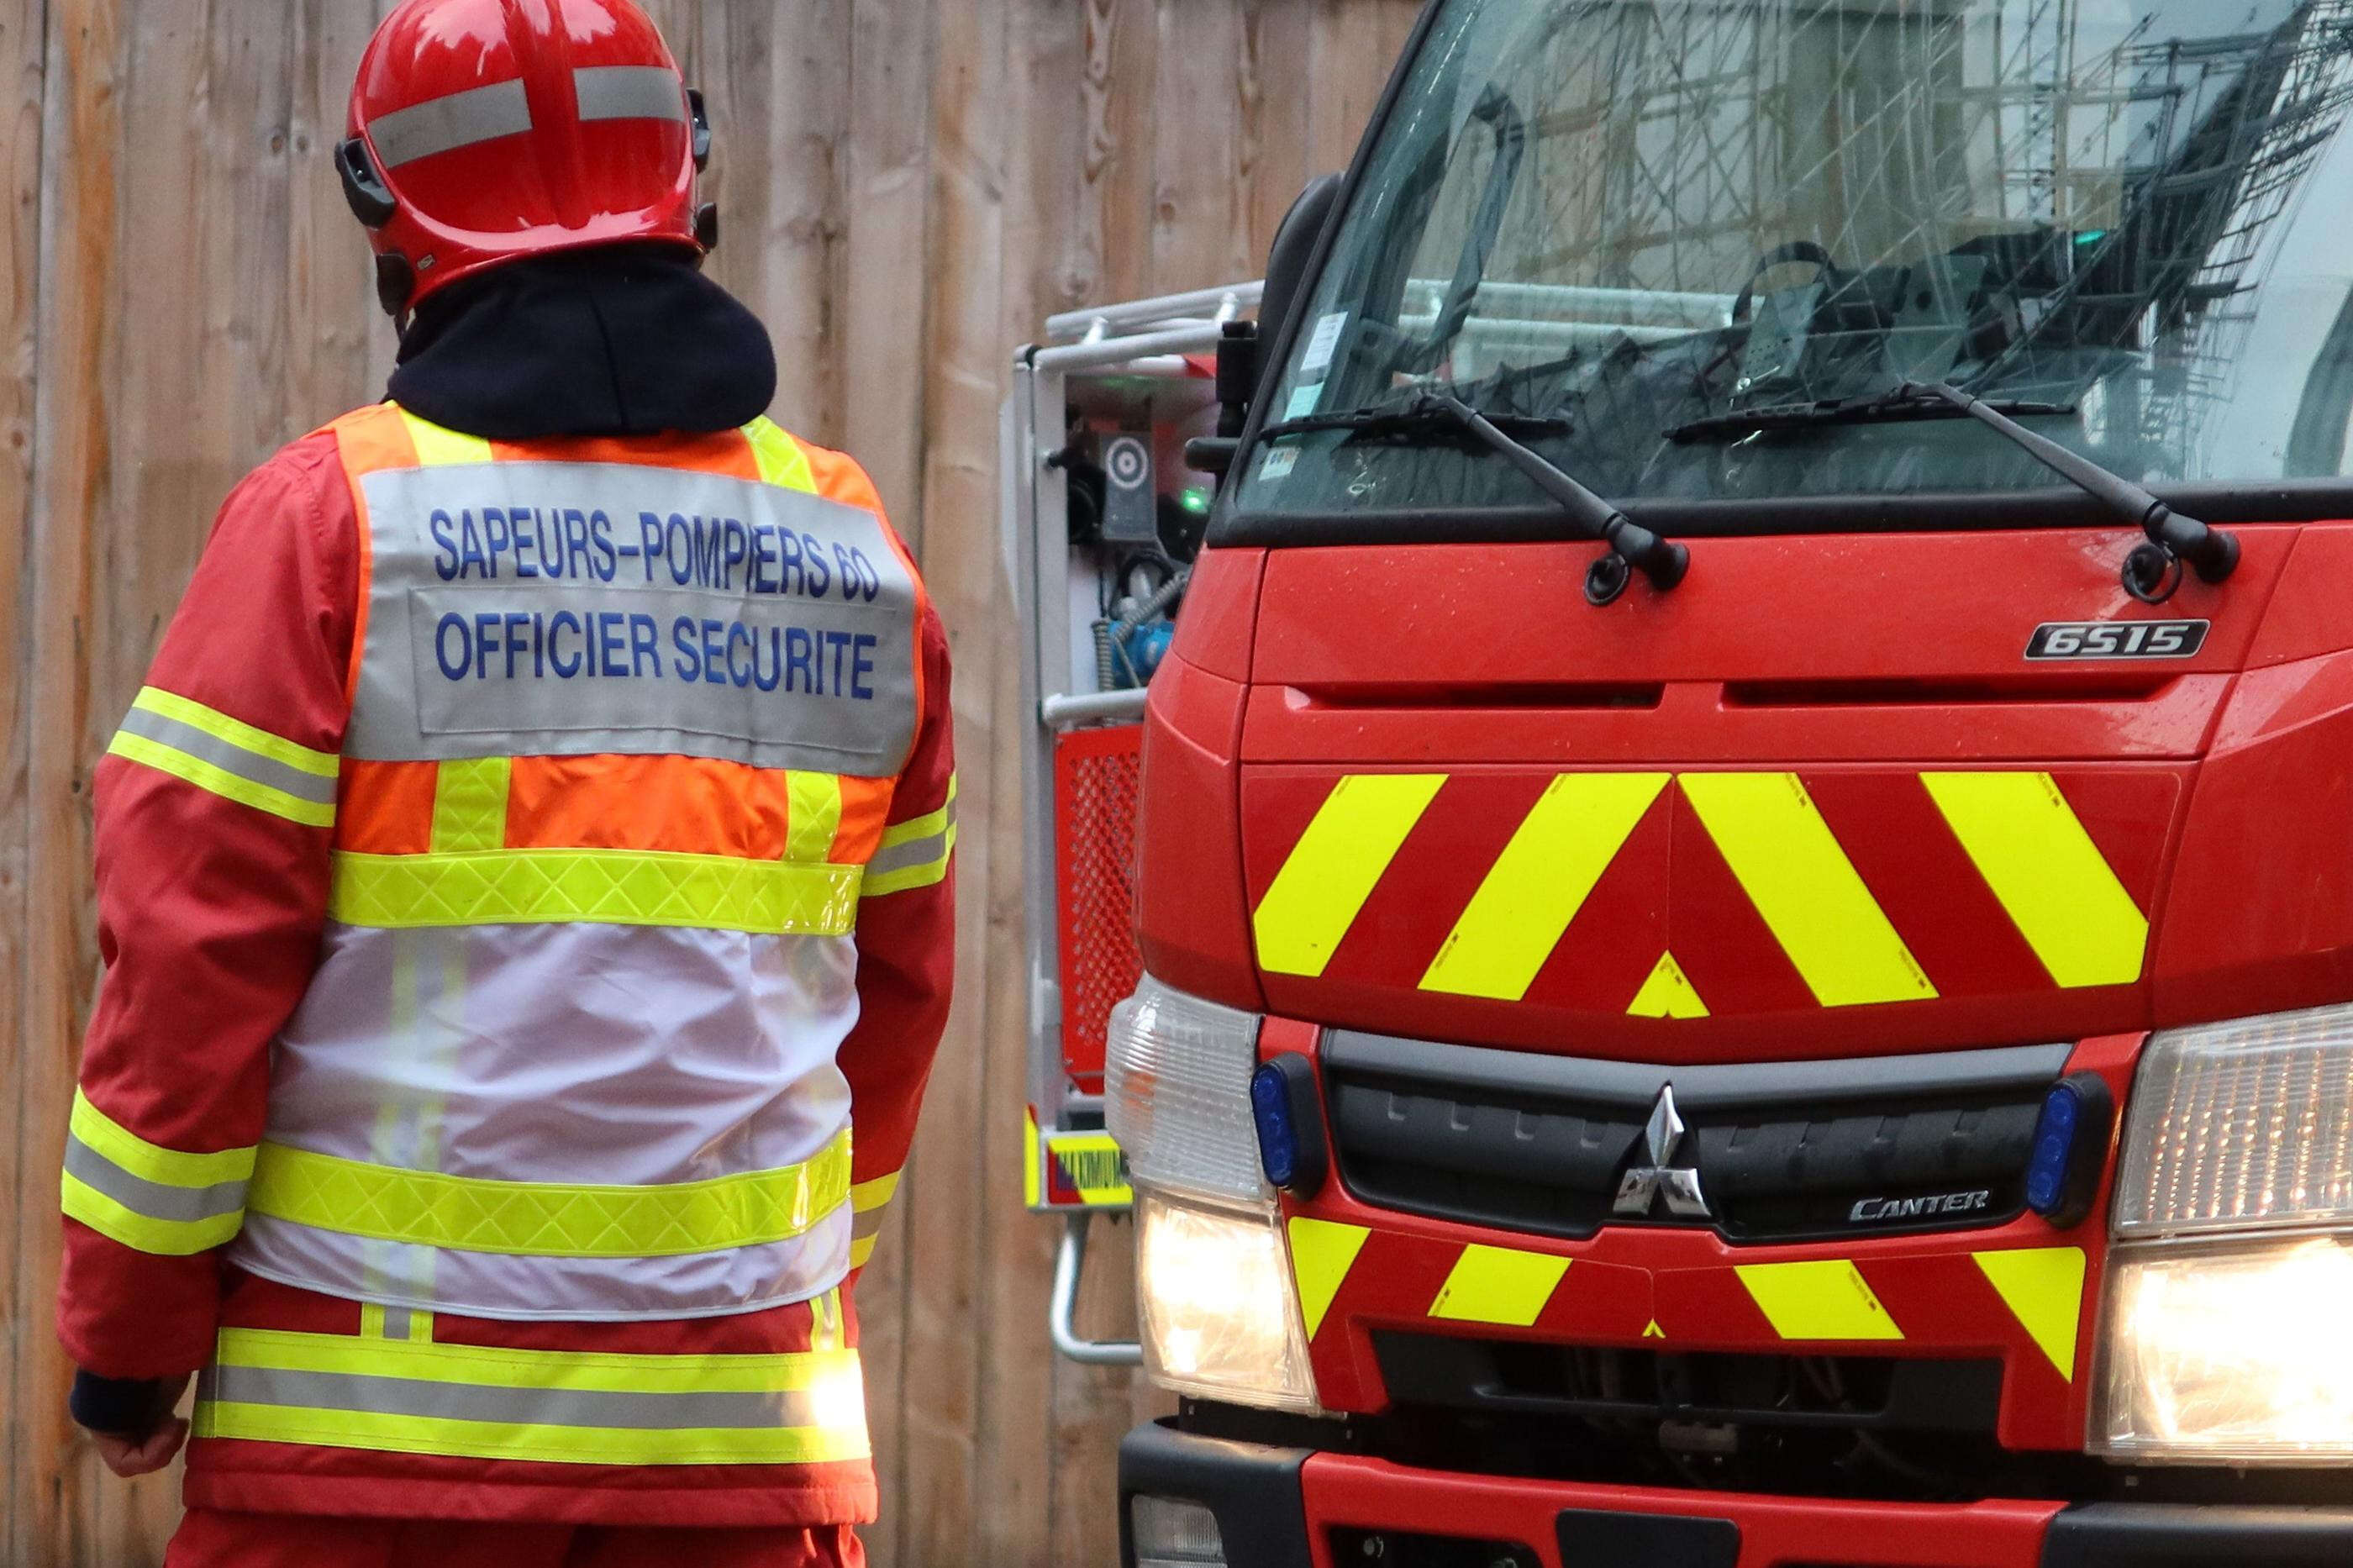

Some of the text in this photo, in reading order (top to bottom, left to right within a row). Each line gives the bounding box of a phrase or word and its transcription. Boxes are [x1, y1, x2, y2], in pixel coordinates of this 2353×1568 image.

[430, 508, 880, 602] SAPEURS-POMPIERS 60
[436, 611, 876, 700] OFFICIER SECURITE
[1850, 1189, 1989, 1221] CANTER
